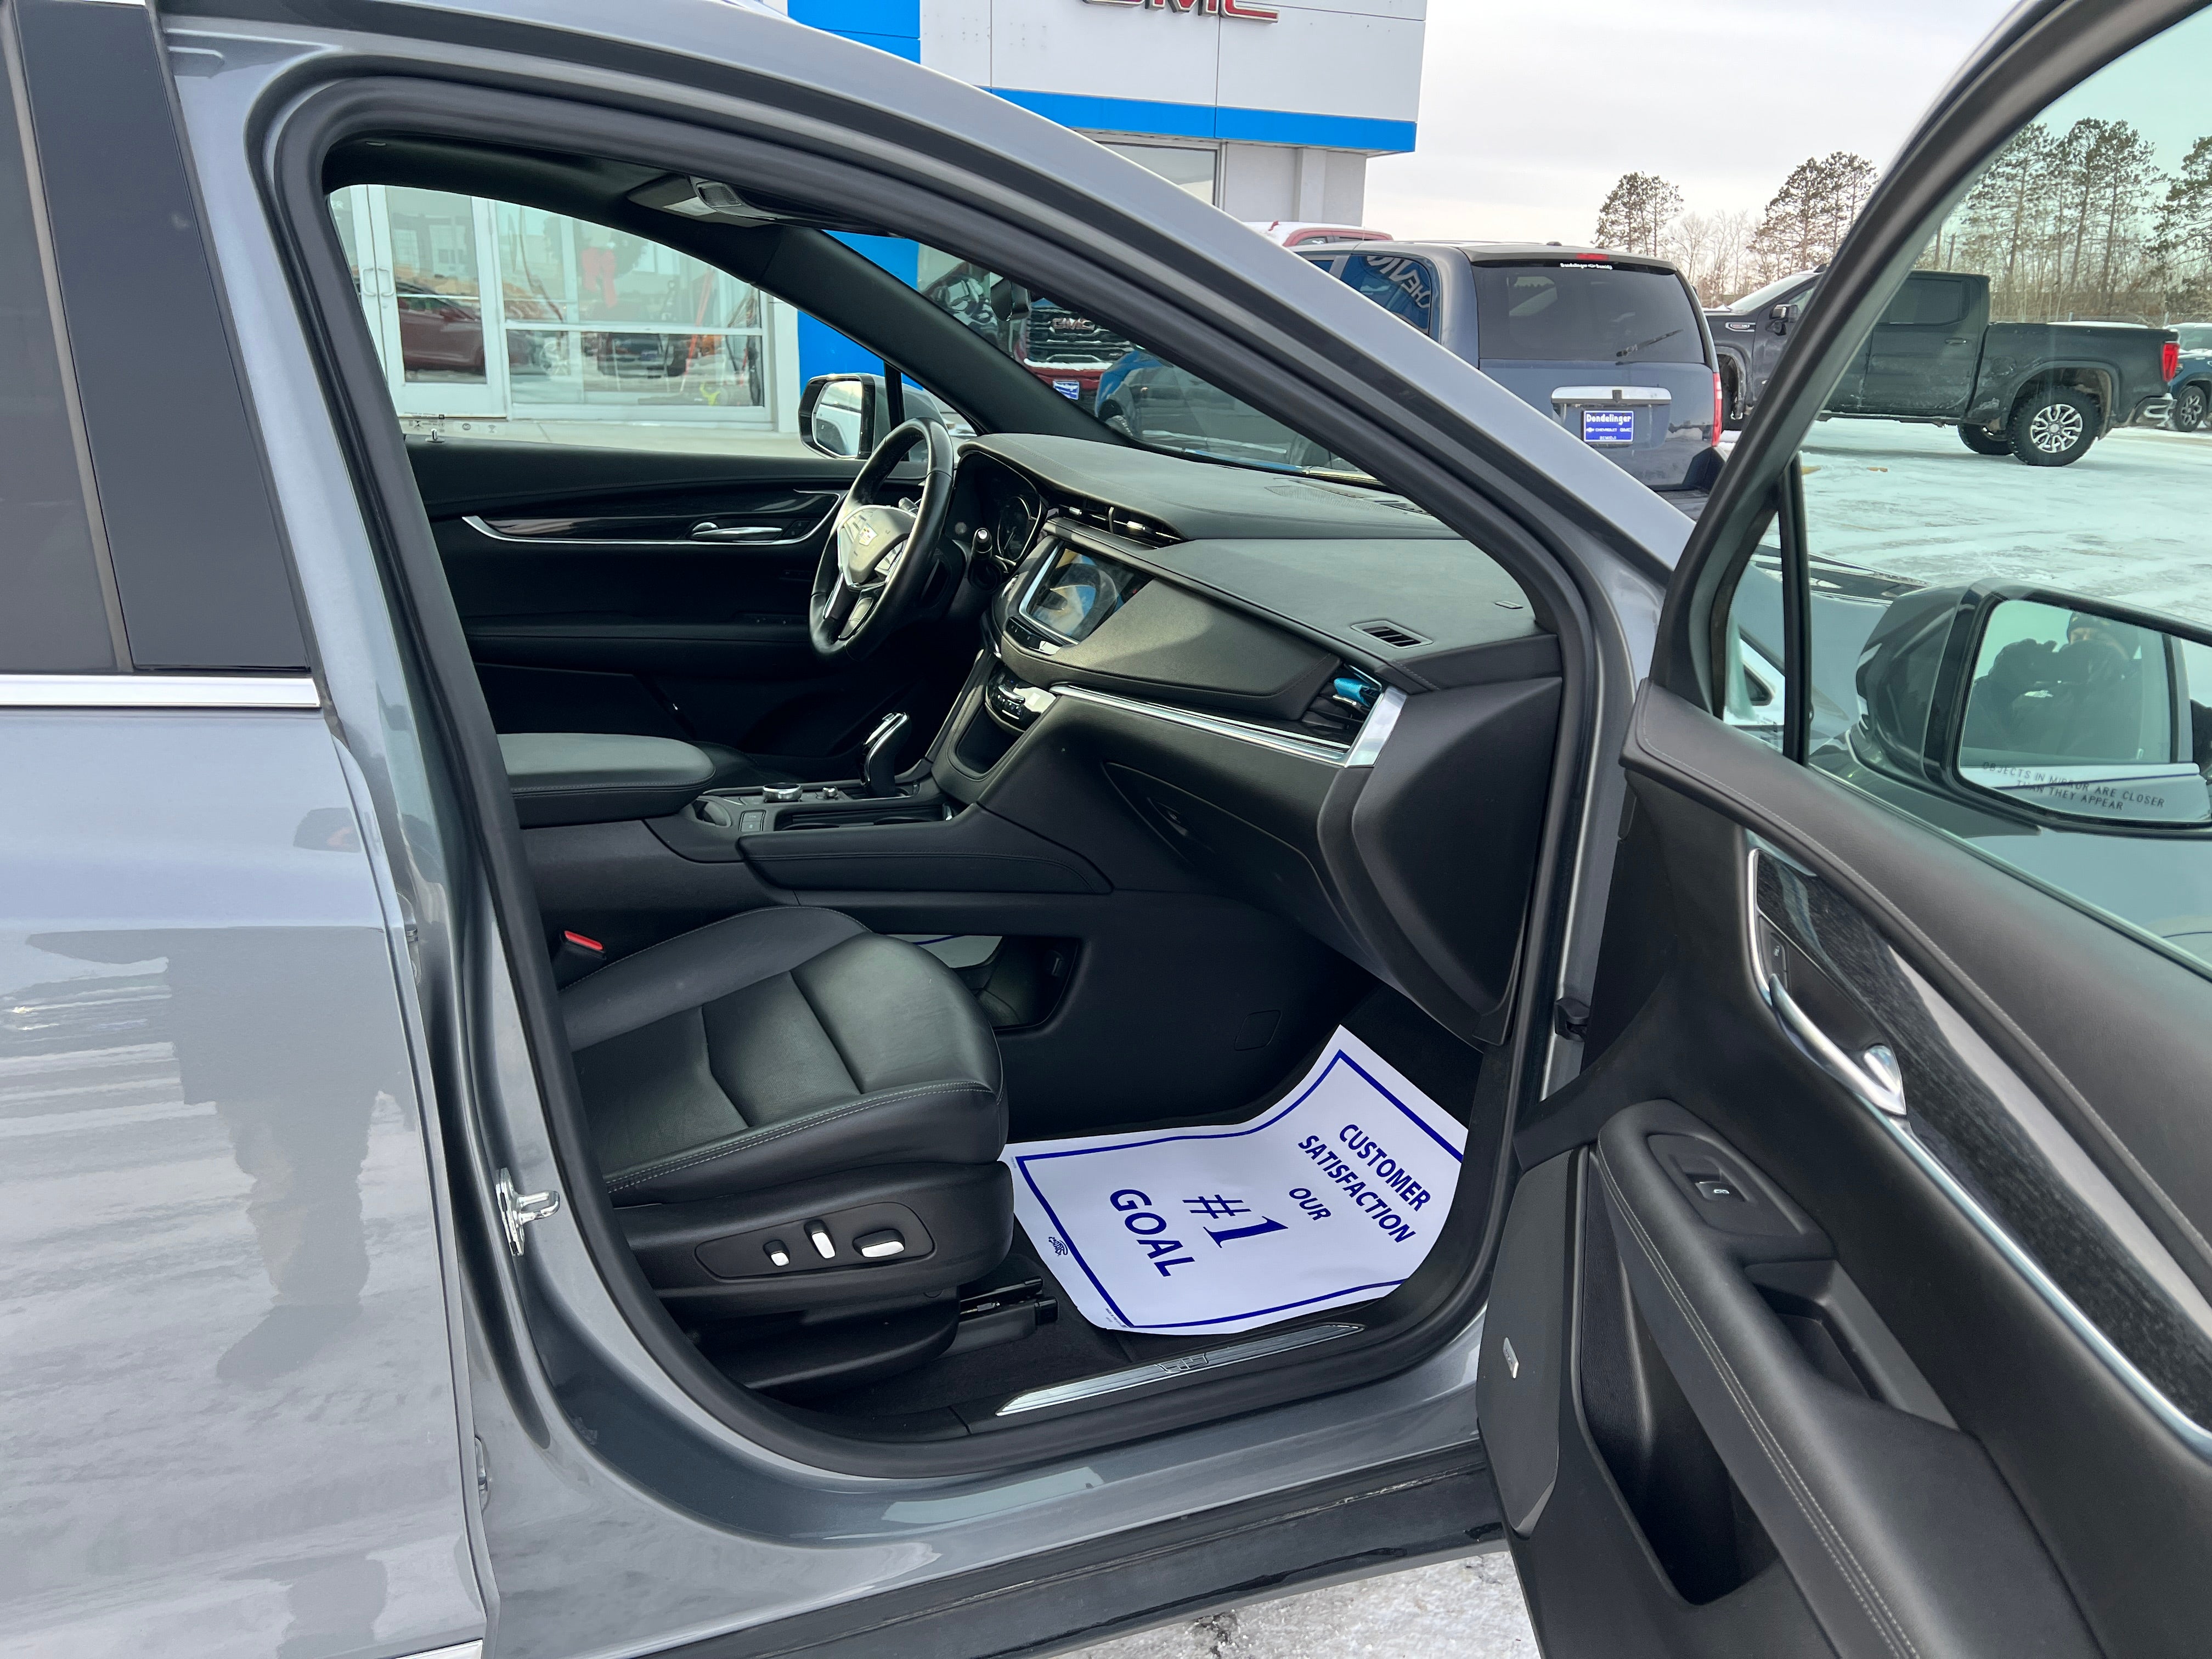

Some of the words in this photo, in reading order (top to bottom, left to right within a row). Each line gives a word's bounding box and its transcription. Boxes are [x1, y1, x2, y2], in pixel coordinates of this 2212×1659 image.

[1585, 413, 1632, 426] Dondelinger
[1983, 761, 2031, 780] OBJECTS
[2035, 772, 2045, 782] IN
[2094, 786, 2117, 798] ARE
[2122, 791, 2165, 808] CLOSER
[2050, 786, 2076, 800] THEY
[2080, 794, 2124, 811] APPEAR
[1297, 1135, 1417, 1243] SATISFACTION
[1339, 1124, 1431, 1212] CUSTOMER
[1182, 1194, 1289, 1249] #1
[1289, 1187, 1332, 1221] OUR
[1109, 1188, 1196, 1277] GOAL
